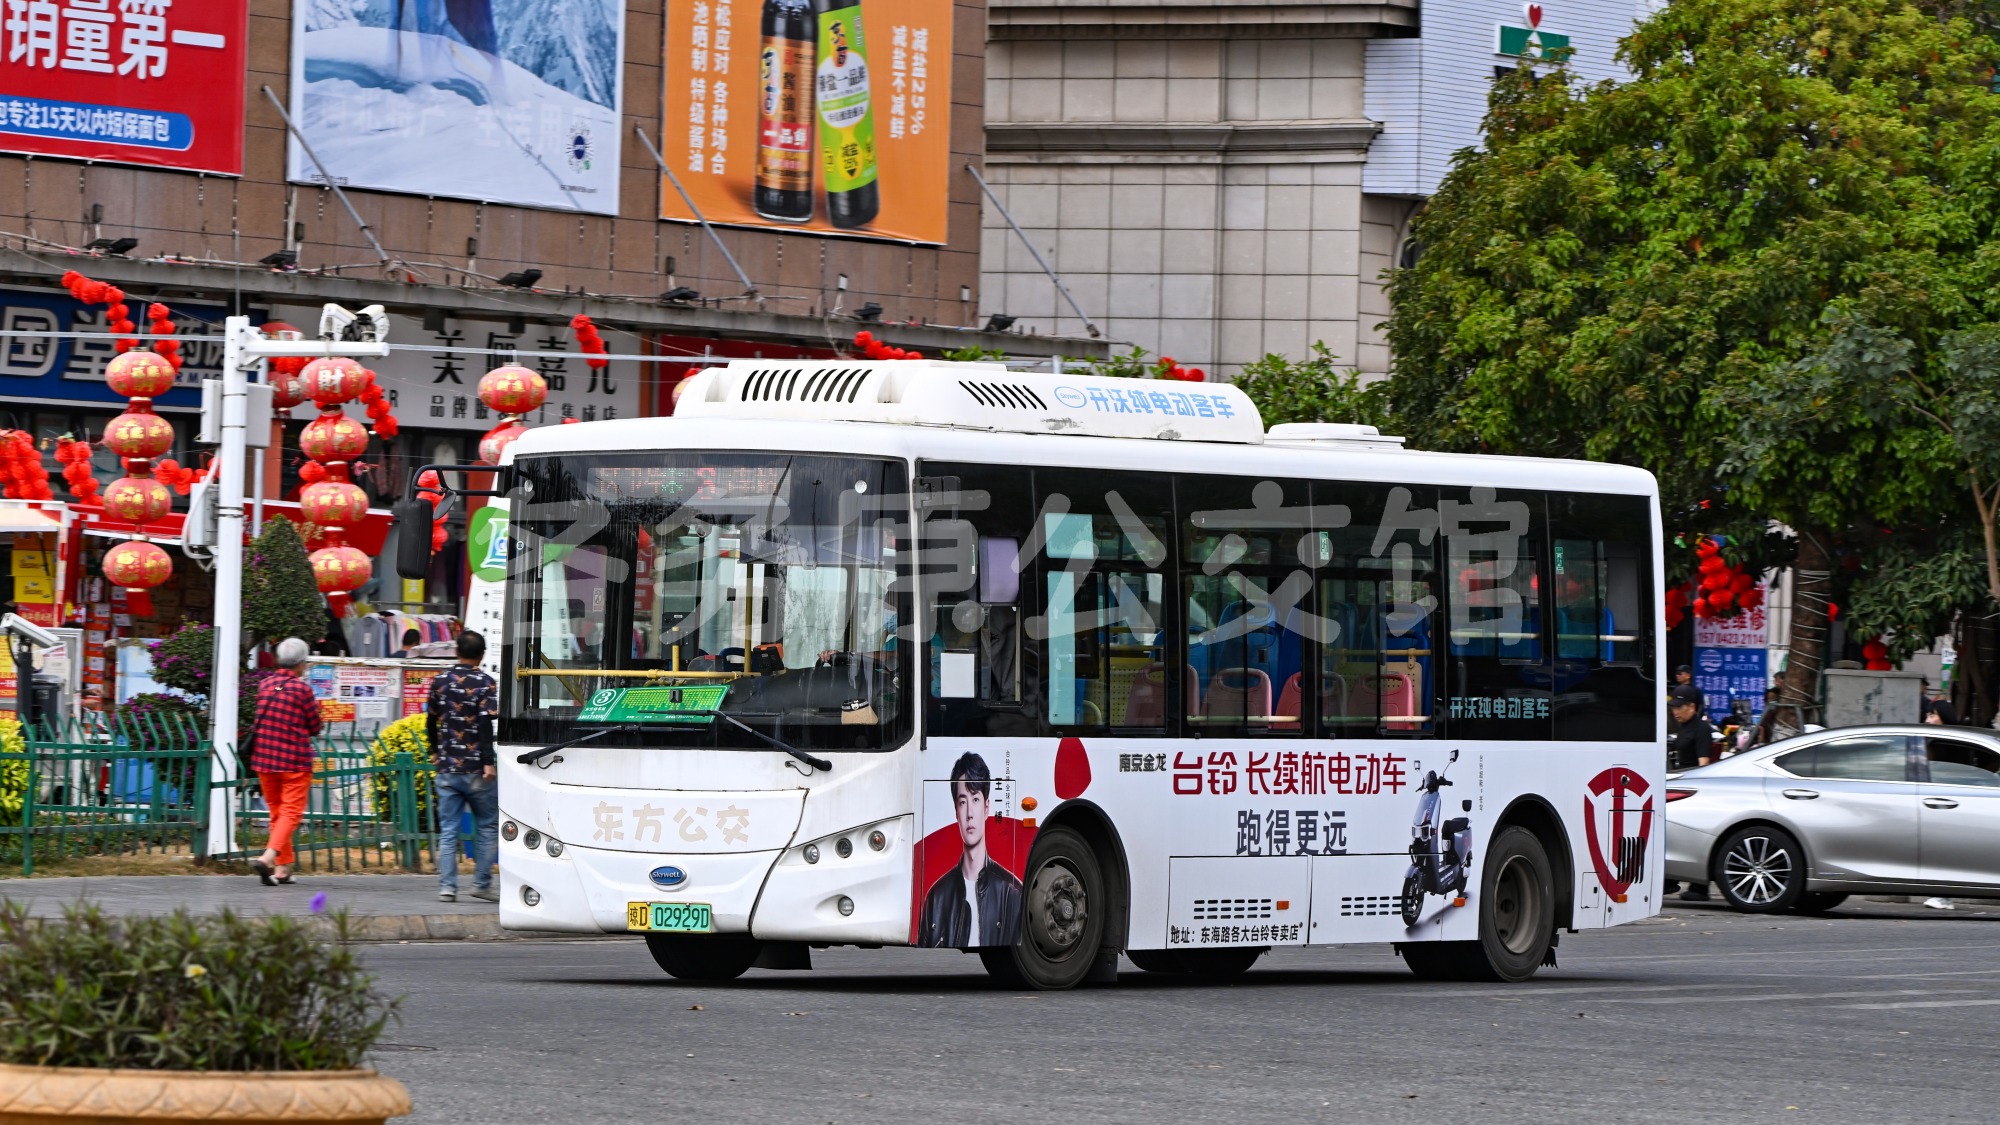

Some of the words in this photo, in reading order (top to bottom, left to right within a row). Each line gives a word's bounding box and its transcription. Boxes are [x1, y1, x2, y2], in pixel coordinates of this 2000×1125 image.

[714, 0, 732, 74] 松应对
[1086, 387, 1235, 419] 开沃纯电动客车
[1450, 697, 1549, 719] 开沃纯电动客车
[1119, 753, 1167, 773] 南京金龙
[592, 801, 750, 843] 东方公交
[1236, 809, 1348, 856] 跑得更远
